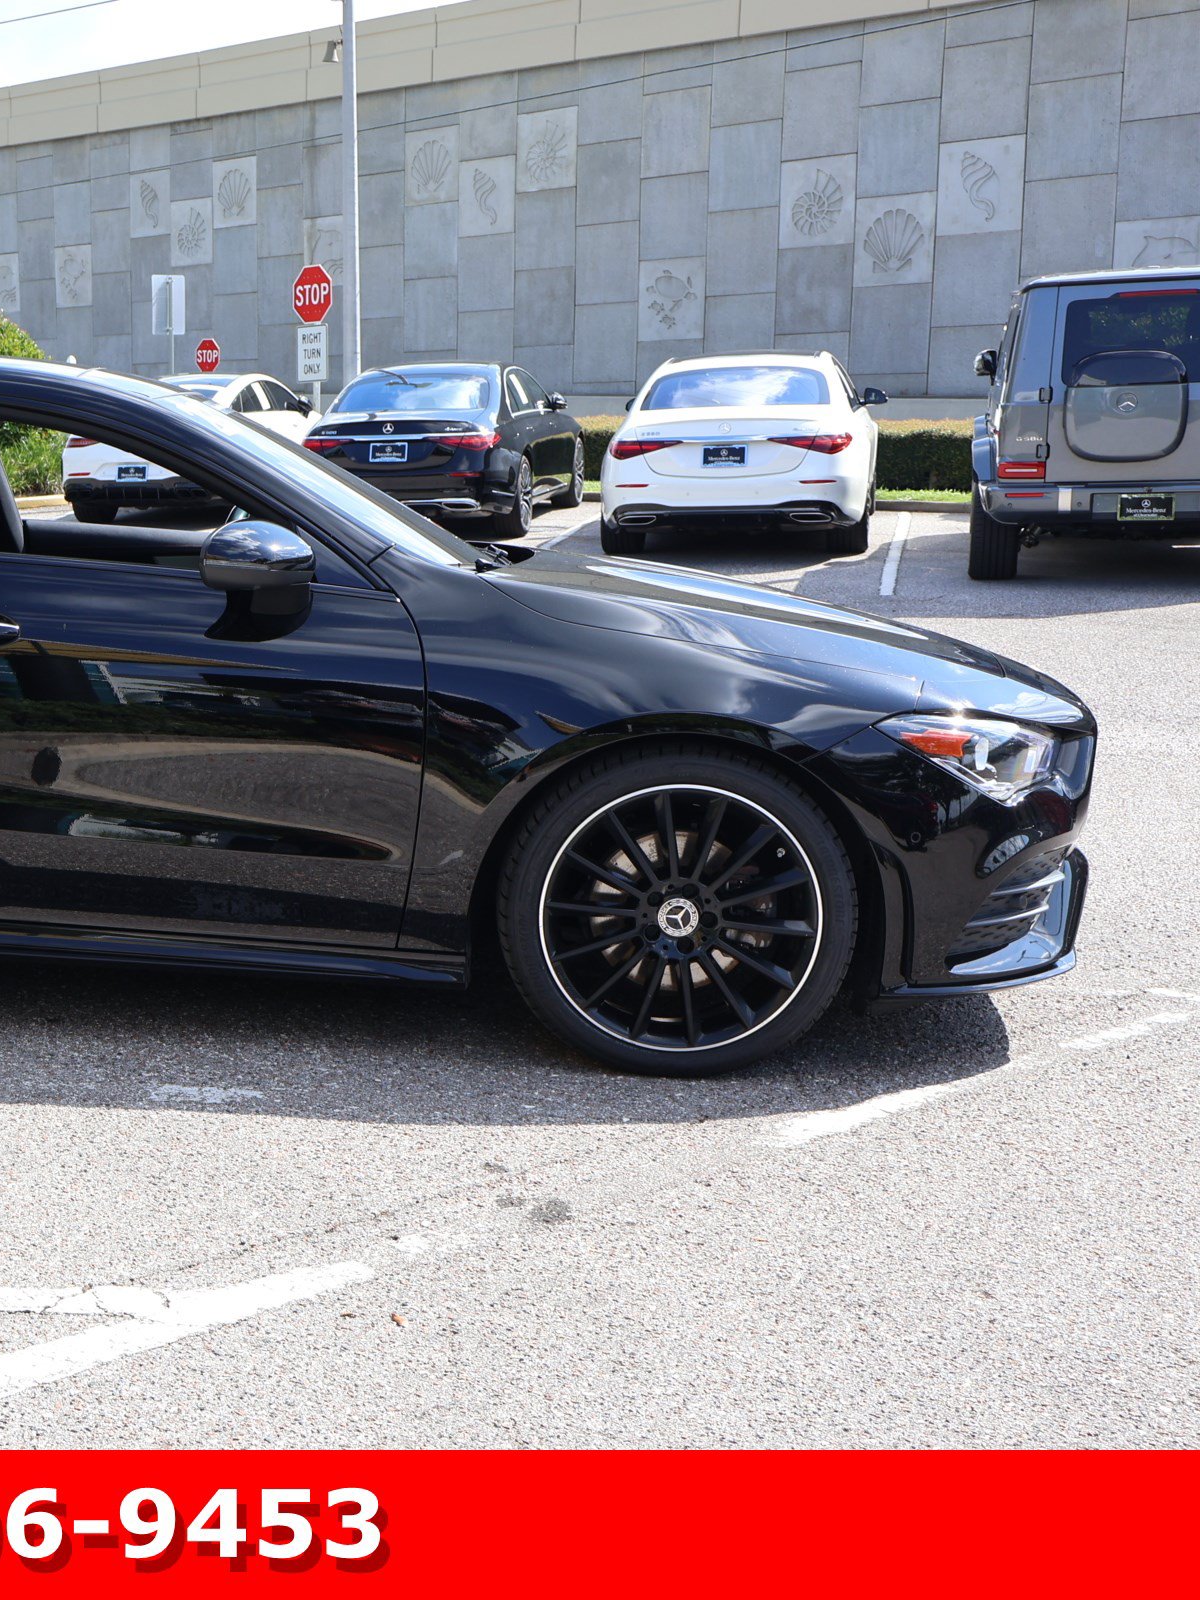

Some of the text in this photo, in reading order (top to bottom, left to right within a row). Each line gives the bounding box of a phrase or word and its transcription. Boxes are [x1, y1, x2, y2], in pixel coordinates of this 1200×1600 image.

[295, 282, 330, 307] STOP
[301, 332, 322, 345] RIGHT
[196, 349, 219, 363] STOP
[303, 348, 321, 360] TURN
[303, 363, 320, 375] ONLY
